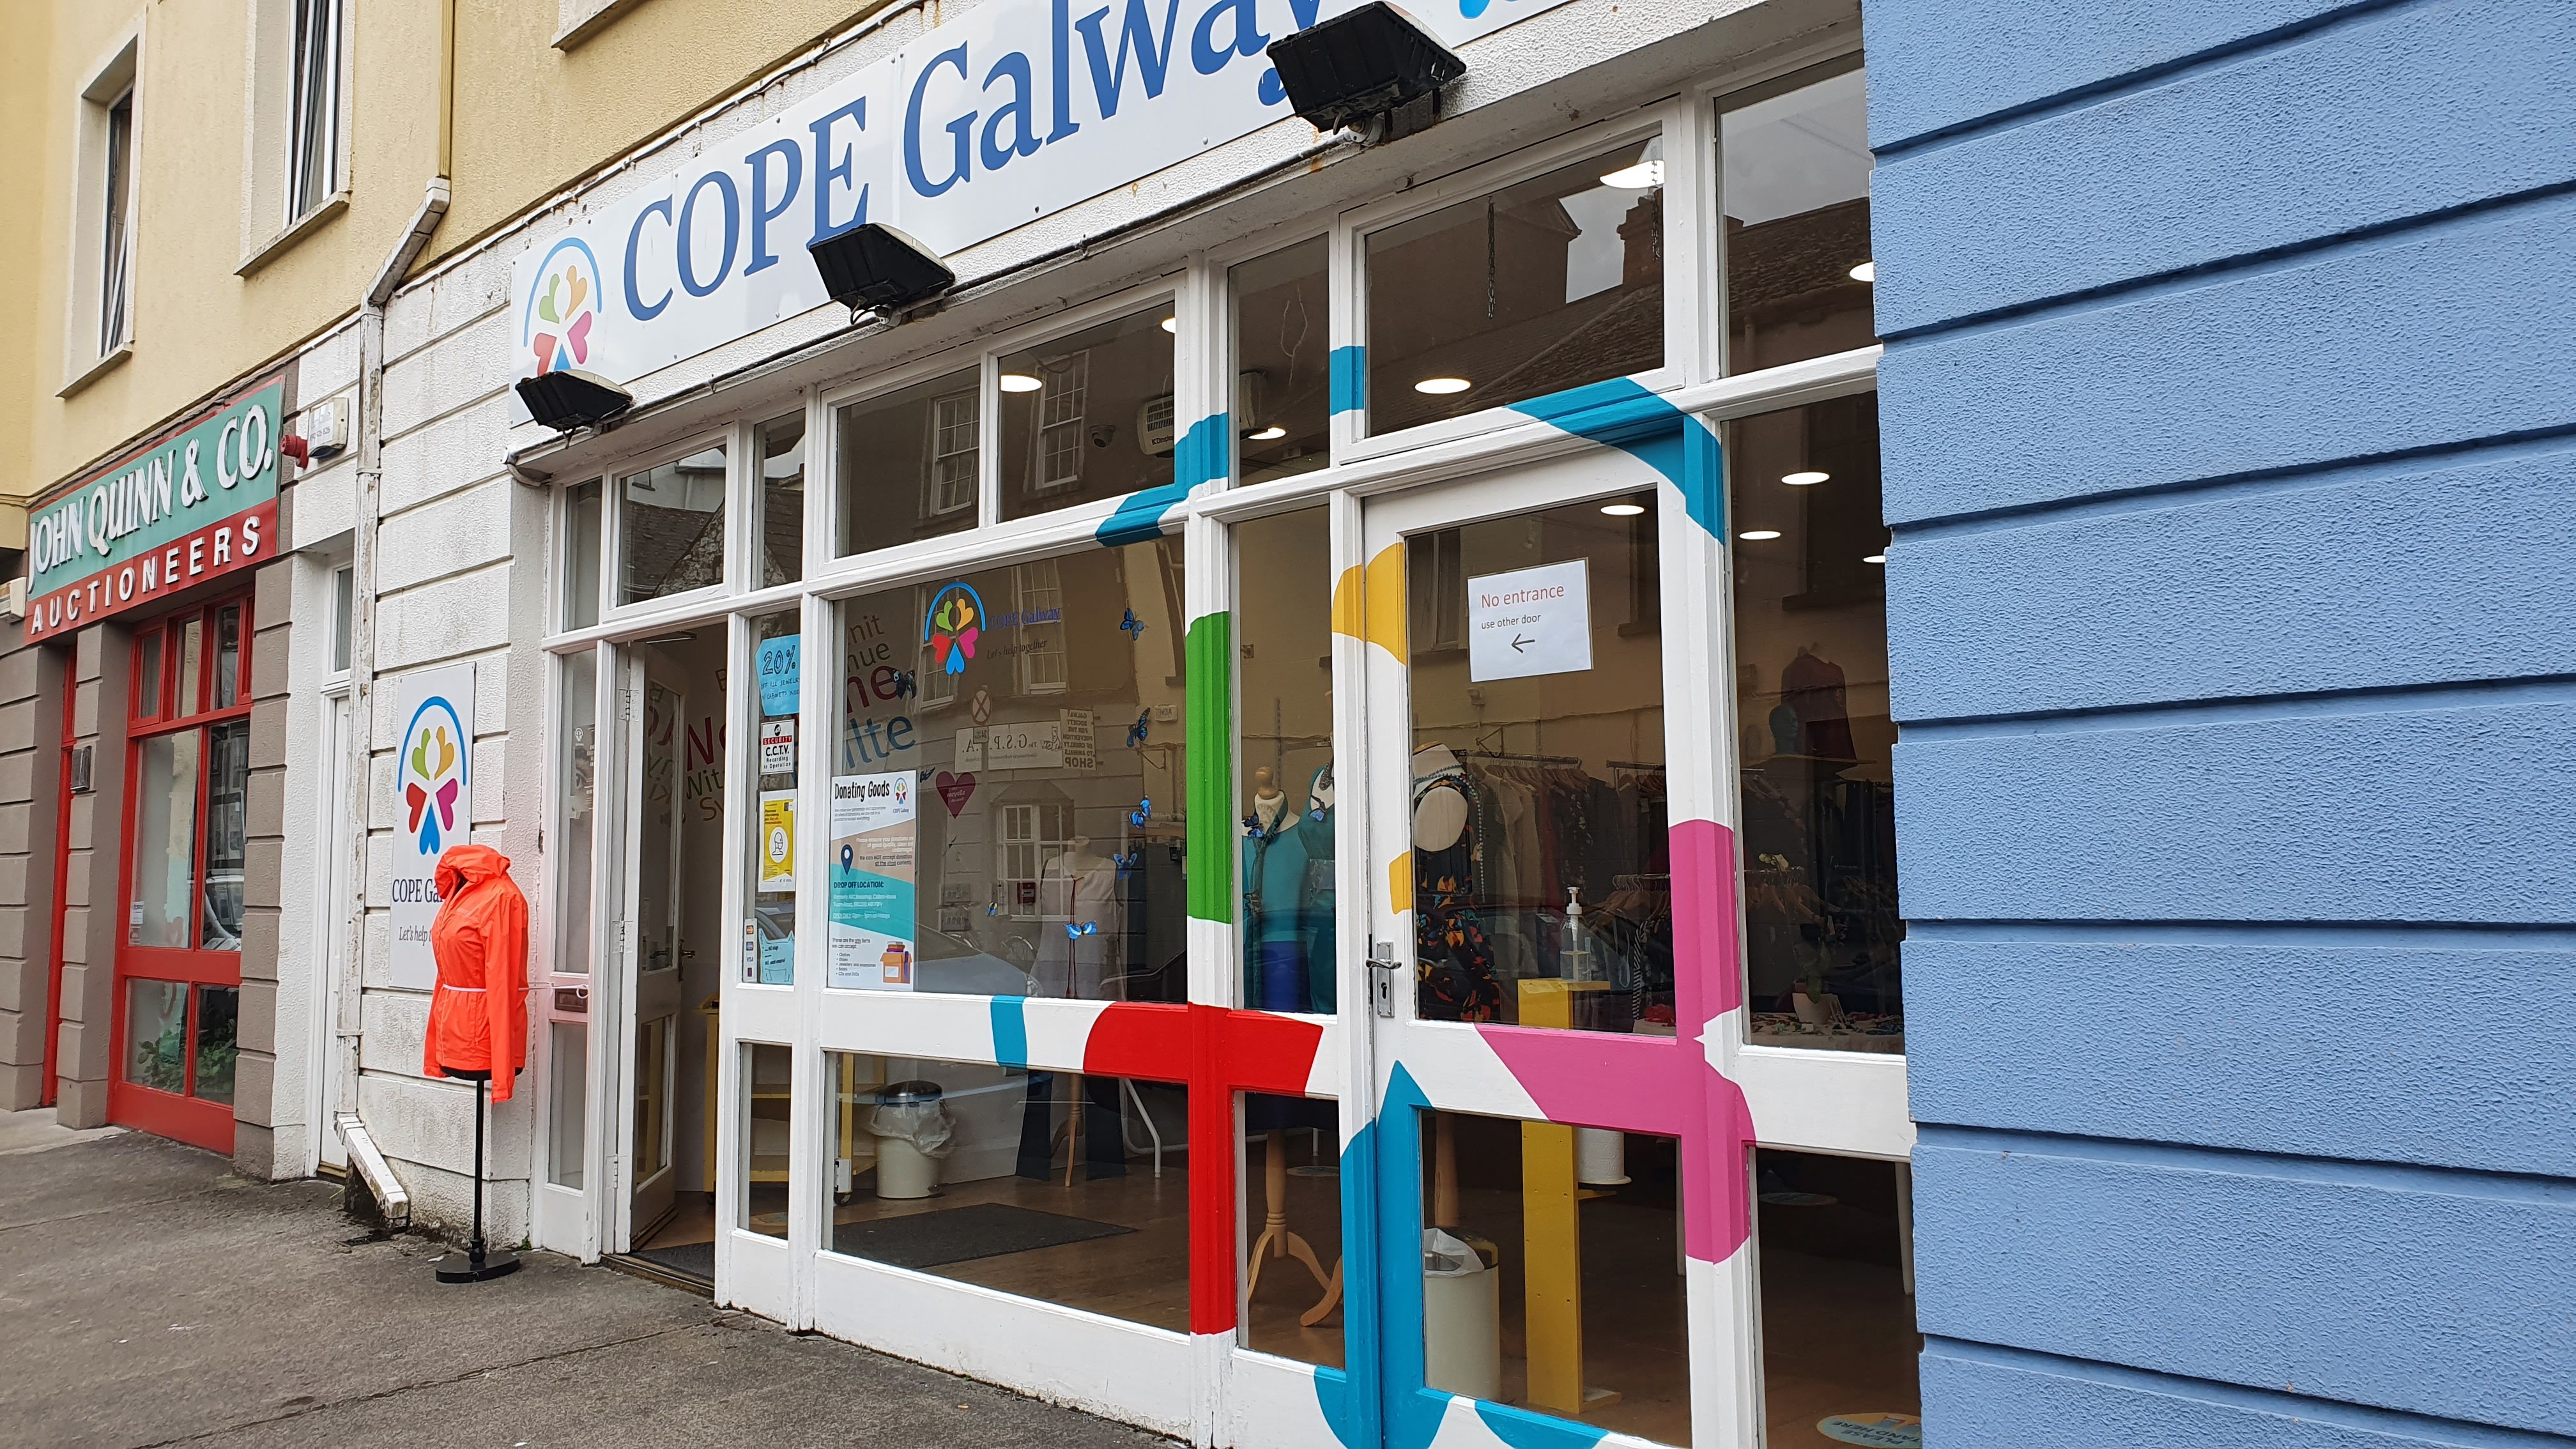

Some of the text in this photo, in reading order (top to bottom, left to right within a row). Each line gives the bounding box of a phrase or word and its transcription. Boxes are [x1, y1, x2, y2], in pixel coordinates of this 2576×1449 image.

[624, 95, 869, 321] COPE
[27, 404, 274, 593] JOHN QUINN & CO.
[30, 516, 261, 634] AUCTIONEERS
[1481, 585, 1565, 608] No entrance
[990, 605, 1061, 629] COPE Galway
[1481, 613, 1542, 629] use other door
[1003, 643, 1018, 657] help
[1019, 638, 1048, 654] together
[762, 645, 796, 676] 20%
[764, 736, 792, 744] SECURITY
[766, 744, 790, 756] C.C.T.V.
[834, 780, 890, 802] Donating Goods
[392, 878, 443, 903] COPE Ga
[399, 925, 414, 941] Let's
[414, 924, 428, 946] help
